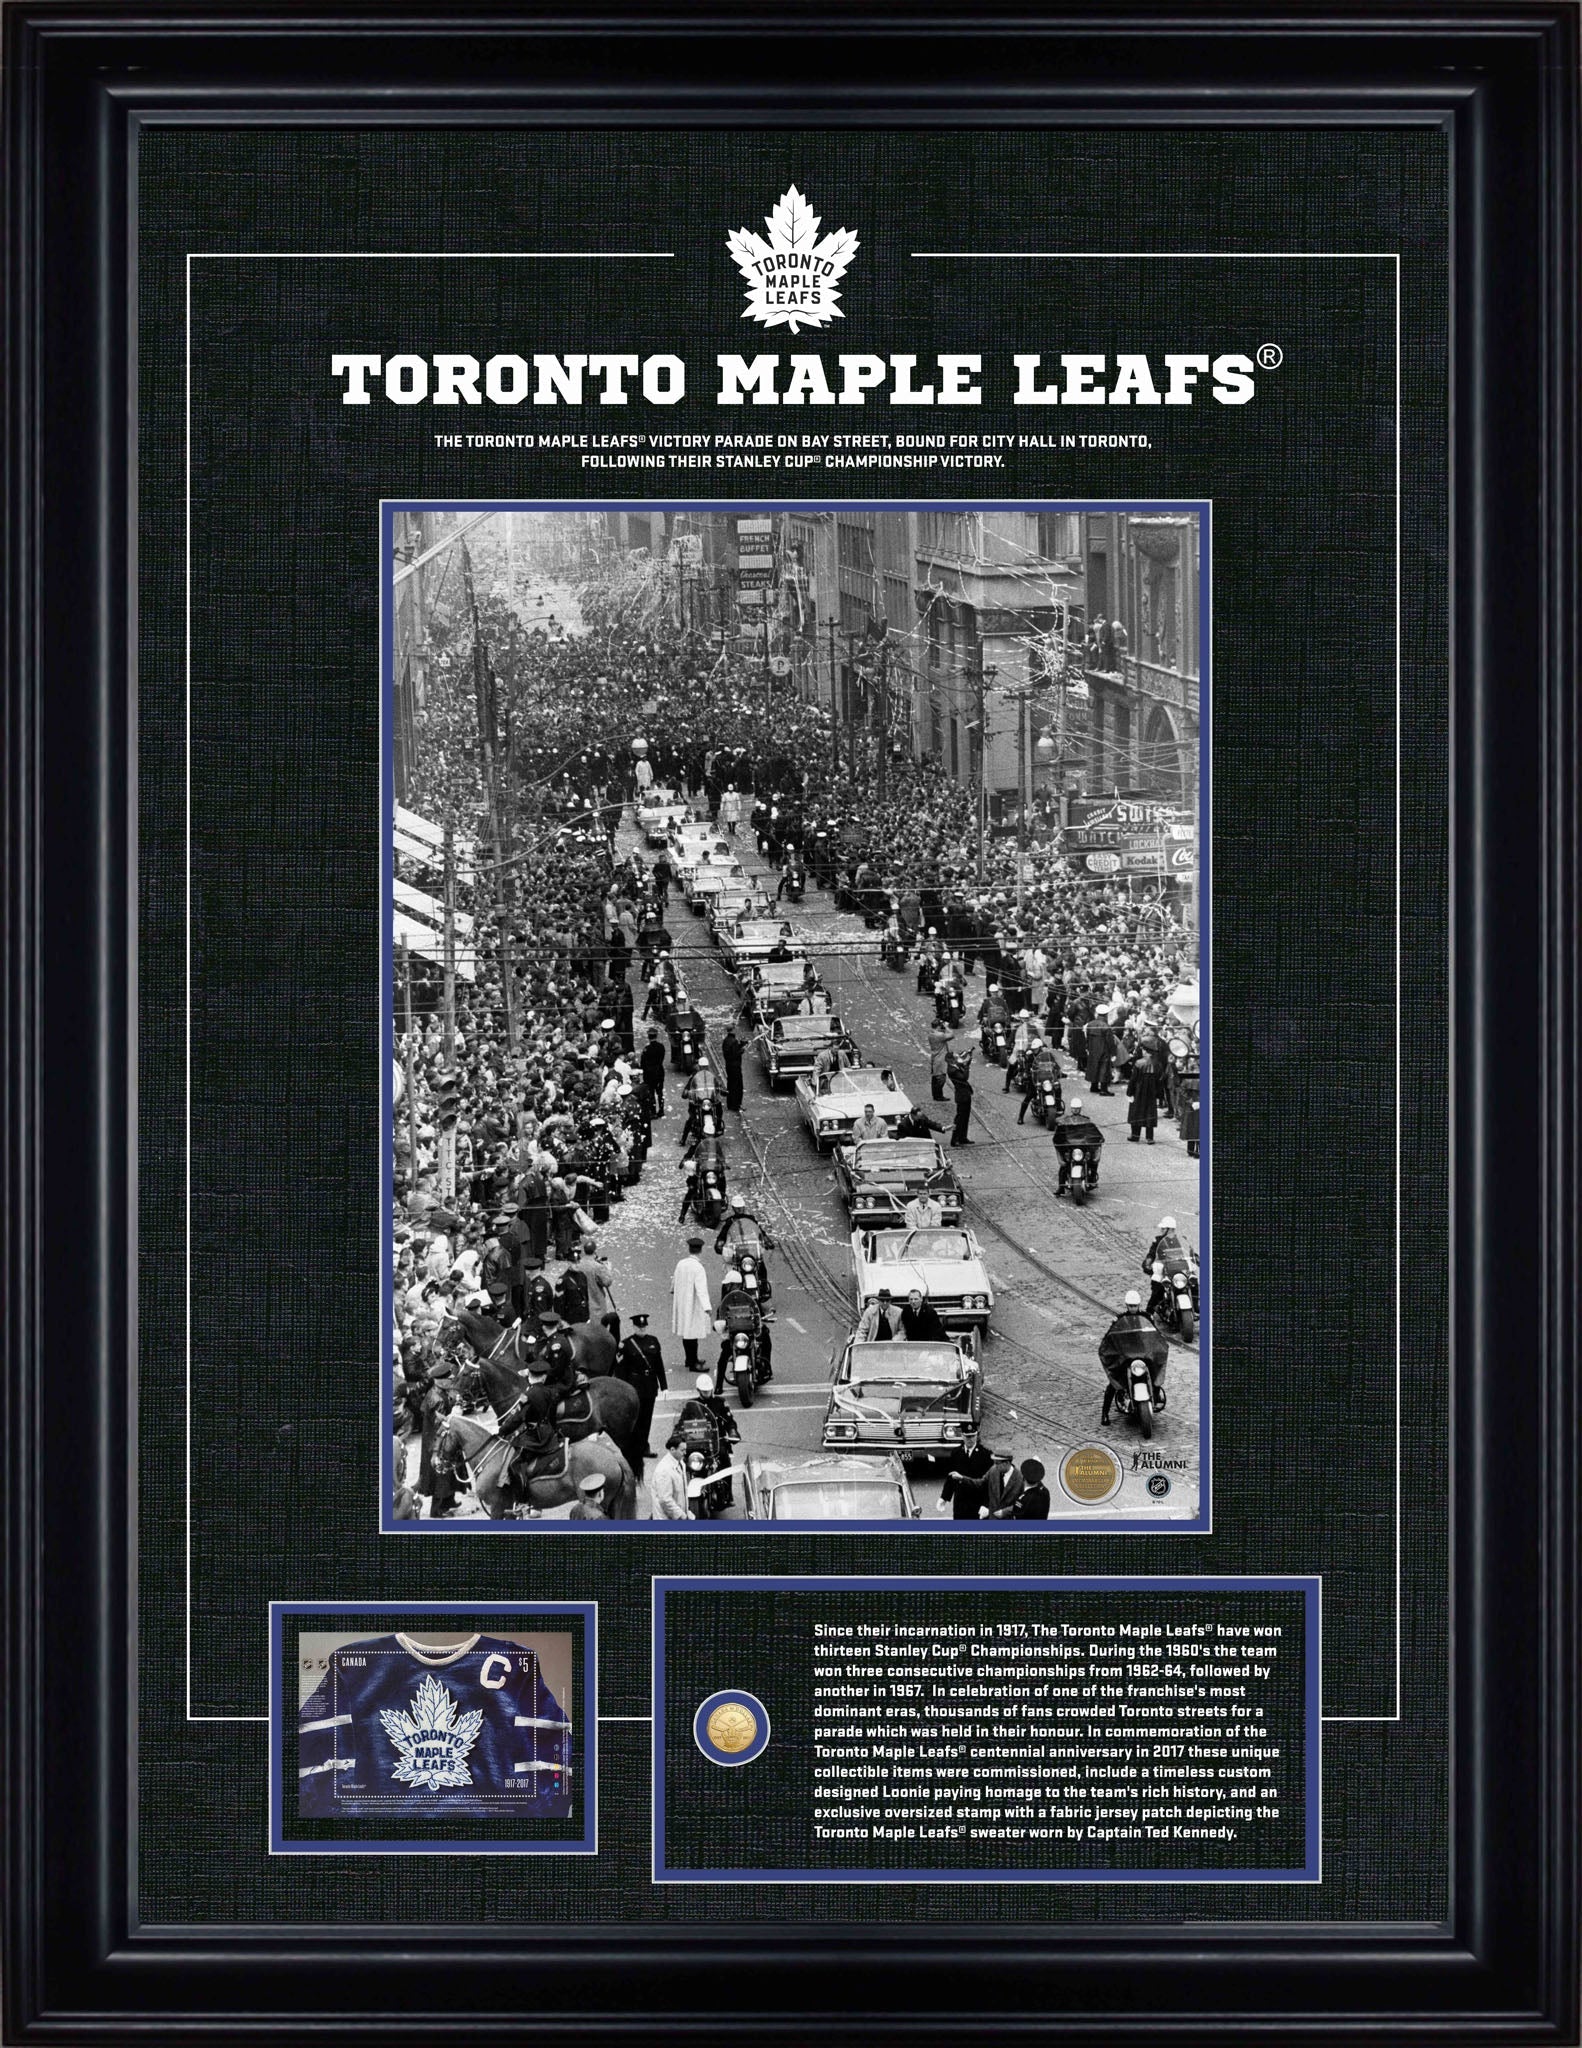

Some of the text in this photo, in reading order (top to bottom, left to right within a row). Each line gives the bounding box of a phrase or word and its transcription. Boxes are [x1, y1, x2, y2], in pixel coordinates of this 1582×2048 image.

[751, 253, 835, 277] TORONTO
[766, 275, 821, 288] MAPLE
[766, 291, 821, 305] LEAFS
[331, 354, 686, 405] TORONTO
[716, 354, 982, 405] MAPLE
[433, 434, 463, 448] THE
[465, 434, 535, 448] TORONTO
[538, 434, 588, 448] MAPLE
[648, 434, 711, 448] VICTORY
[714, 434, 774, 448] PARADE
[777, 434, 798, 448] ON
[801, 434, 830, 448] BAY
[833, 434, 892, 450] STREET,
[895, 434, 946, 448] BOUND
[949, 434, 978, 448] FOR
[982, 434, 1016, 448] CITY
[1018, 434, 1057, 448] HALL
[1060, 435, 1076, 448] IN
[1078, 434, 1152, 450] TORONTO,
[581, 454, 665, 468] FOLLOWING
[668, 455, 712, 468] THEIR
[716, 454, 781, 468] STANLEY
[825, 454, 938, 468] CHAMPIONSHIP
[939, 455, 1005, 468] VICTORY.
[739, 535, 771, 543] FRENCH
[739, 545, 770, 553] BUFFET
[741, 581, 773, 589] STEAKS
[1087, 859, 1118, 867] CREDIT
[1127, 855, 1158, 866] Kodak
[444, 1137, 453, 1171] TTC
[814, 1623, 854, 1637] Since
[856, 1623, 891, 1637] their
[894, 1623, 976, 1637] incarnation
[980, 1623, 993, 1637] in
[996, 1623, 1029, 1639] 1917,
[1031, 1623, 1058, 1637] The
[1060, 1623, 1116, 1637] Toronto
[1119, 1623, 1162, 1640] Maple
[1217, 1623, 1250, 1637] have
[1253, 1627, 1282, 1637] won
[813, 1643, 871, 1657] thirteen
[874, 1644, 929, 1660] Stanley
[970, 1643, 1085, 1660] Championships.
[1089, 1643, 1136, 1660] During
[1138, 1644, 1162, 1657] the
[1165, 1644, 1211, 1657] 1960's
[1213, 1644, 1237, 1657] the
[1240, 1645, 1277, 1657] team
[341, 1657, 367, 1667] CANADA
[480, 1653, 512, 1689] C
[813, 1663, 1271, 1680] won three consecutive championships from 1962-64, followed by
[814, 1684, 1246, 1697] another in 1967. In celebration of one of the franchise's most
[814, 1704, 1264, 1719] dominant eras, thousands of fans crowded Toronto streets for a
[402, 1729, 464, 1749] TORONTO
[814, 1724, 1267, 1741] parade which was held in their honour. In commemoration of the
[415, 1747, 454, 1758] MAPLE
[813, 1744, 869, 1758] Toronto
[872, 1744, 915, 1761] Maple
[970, 1744, 1045, 1758] centennial
[1049, 1744, 1133, 1761] anniversary
[1136, 1744, 1149, 1758] in
[1153, 1744, 1185, 1758] 2017
[1187, 1744, 1228, 1758] these
[1231, 1744, 1280, 1761] unique
[413, 1759, 456, 1770] LEAFS
[814, 1764, 1271, 1780] collectible items were commissioned, include a timeless custom
[504, 1778, 529, 1789] 1917-2017
[814, 1785, 1278, 1802] designed Loonie paying homage to the team's rich history, and an
[814, 1805, 1280, 1822] exclusive oversized stamp with a fabric jersey patch depicting the
[813, 1825, 869, 1838] Toronto
[872, 1825, 916, 1842] Maple
[970, 1826, 1027, 1838] sweater
[1028, 1828, 1063, 1838] worn
[1067, 1825, 1084, 1841] by
[1087, 1825, 1142, 1842] Captain
[1144, 1825, 1169, 1838] Ted
[1173, 1825, 1238, 1842] Kennedy.
